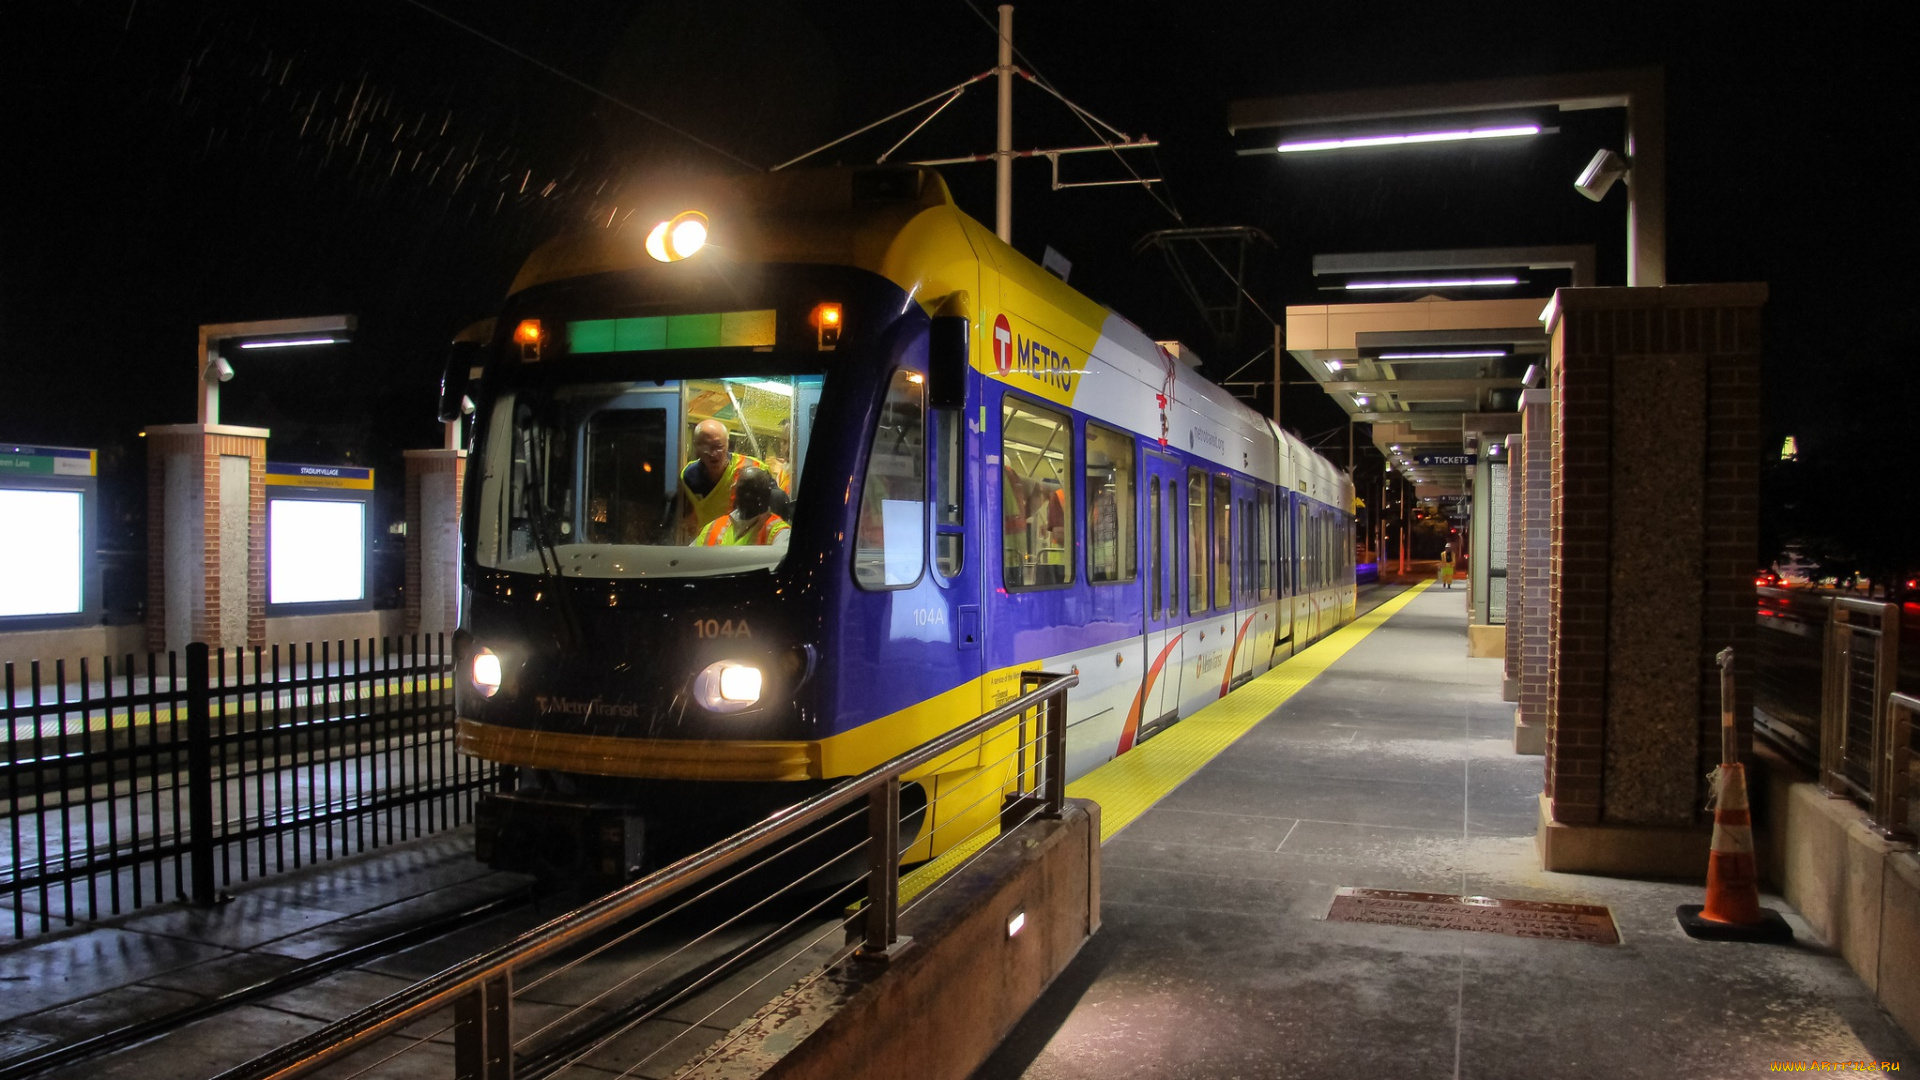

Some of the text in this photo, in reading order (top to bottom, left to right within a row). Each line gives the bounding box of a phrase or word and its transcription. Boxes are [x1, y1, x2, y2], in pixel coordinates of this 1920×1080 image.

[1018, 333, 1071, 392] METRO
[1434, 456, 1469, 464] TICKETS
[301, 467, 339, 476] STADIUM VILLAGE
[913, 607, 944, 626] 104A
[694, 618, 752, 639] 104A
